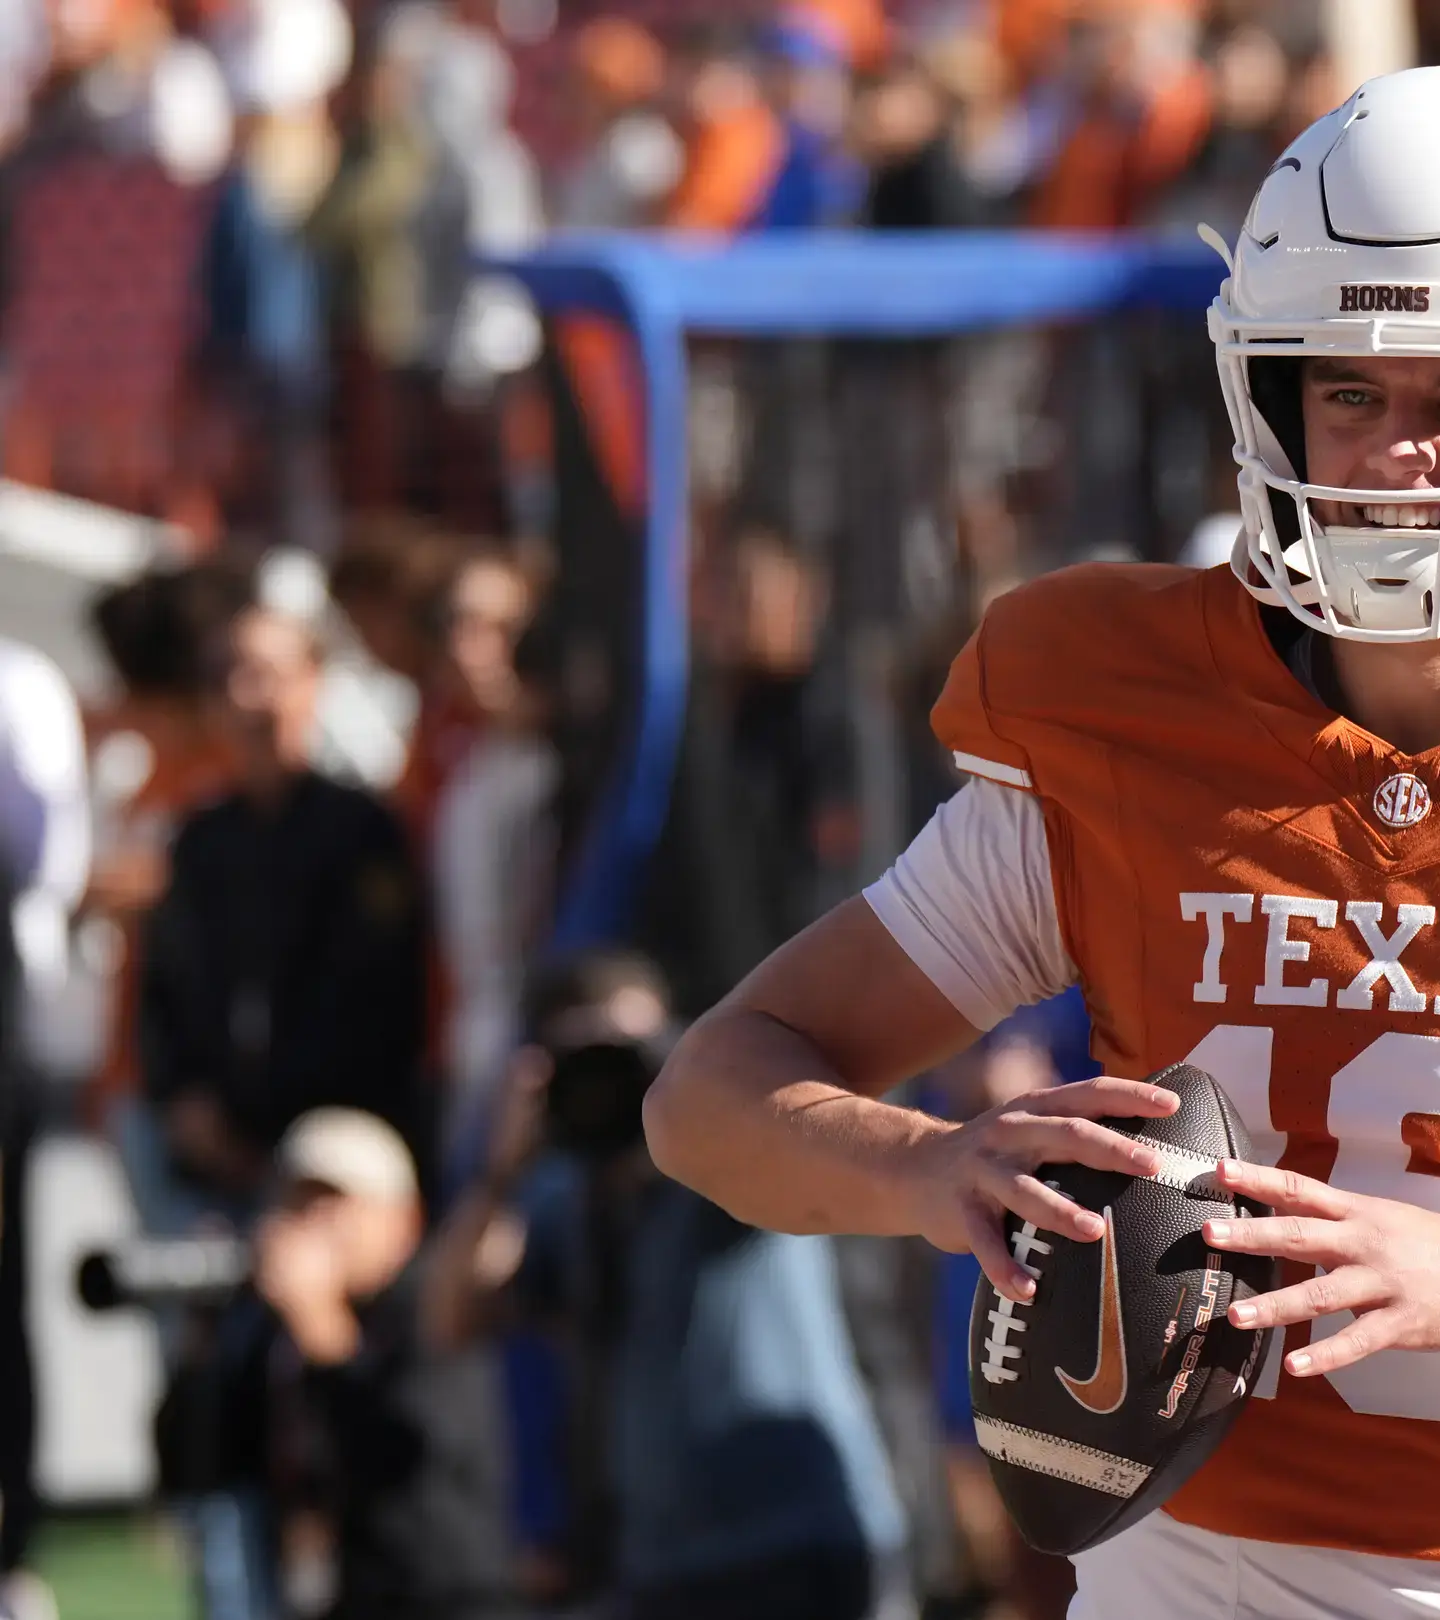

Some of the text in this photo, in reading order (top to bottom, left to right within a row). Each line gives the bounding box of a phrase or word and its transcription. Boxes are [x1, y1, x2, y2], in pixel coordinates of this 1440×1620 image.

[1339, 285, 1430, 312] HORNS
[1378, 777, 1425, 822] SEC
[1157, 1252, 1222, 1419] VAPOR ELITE
